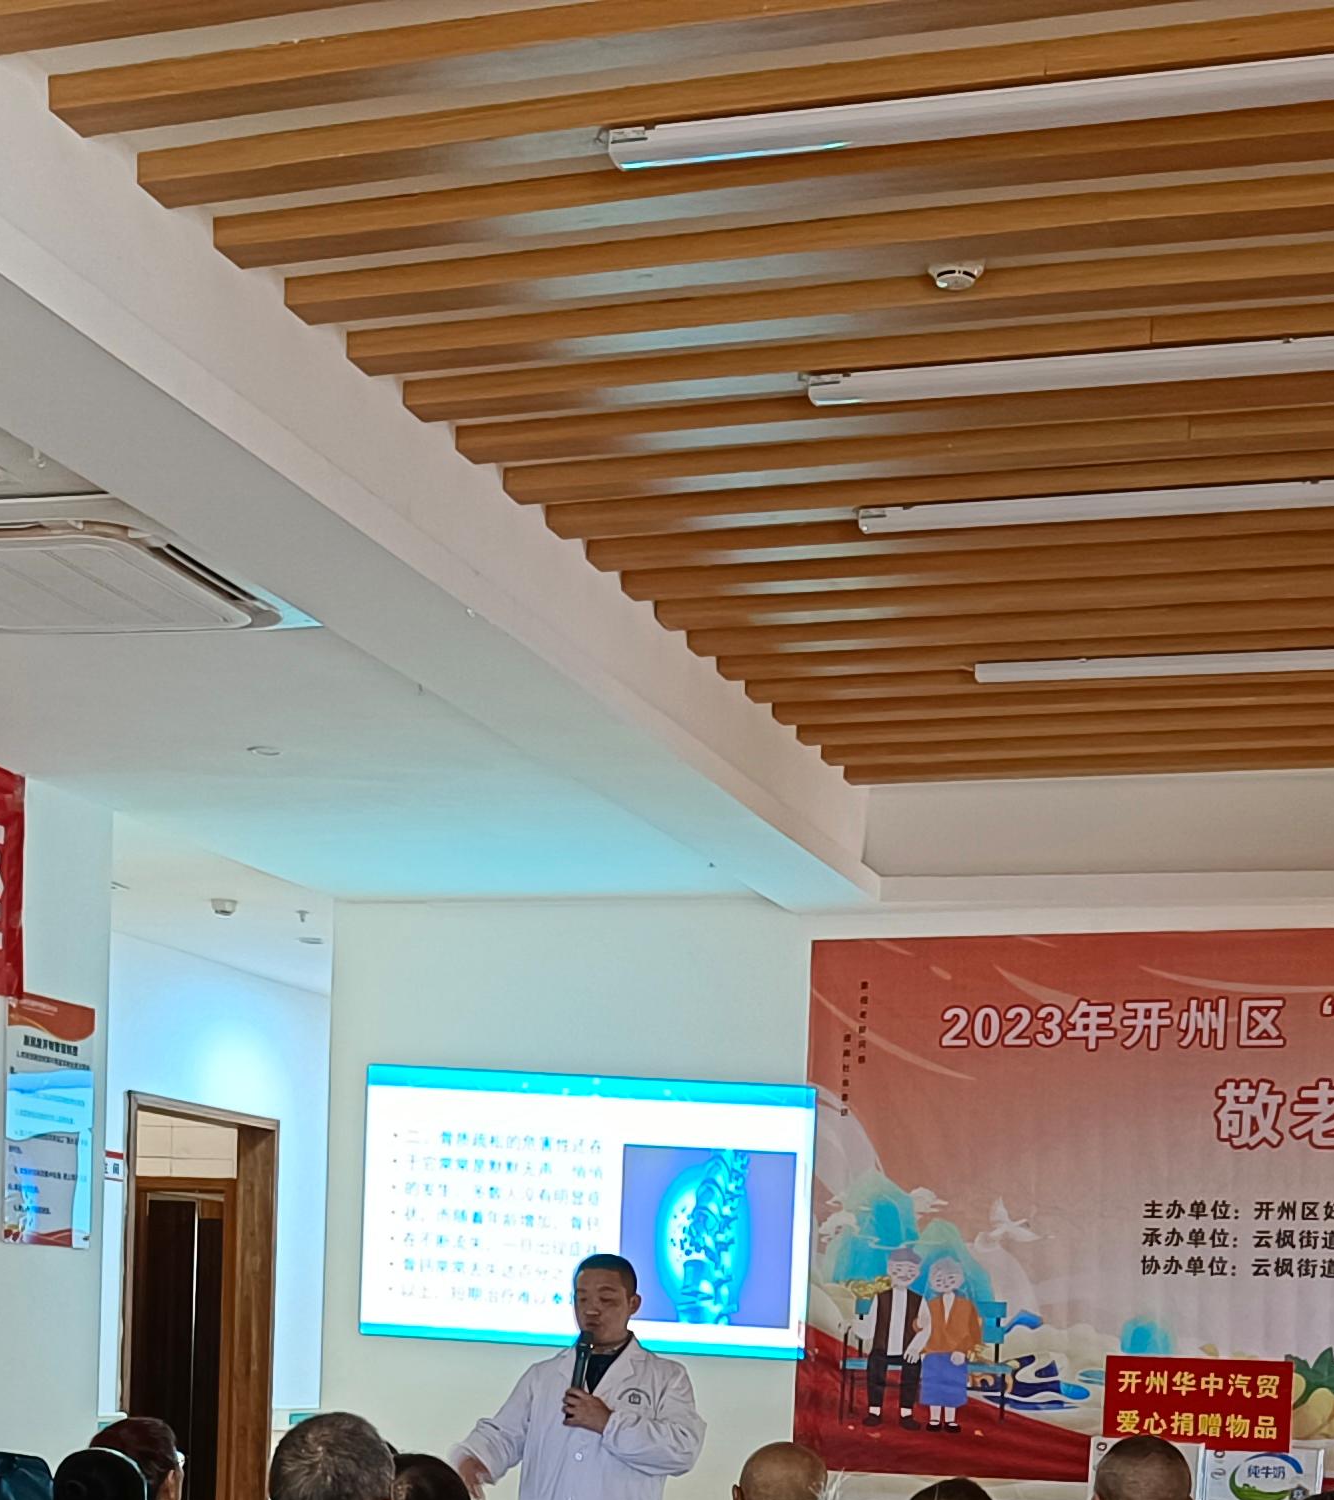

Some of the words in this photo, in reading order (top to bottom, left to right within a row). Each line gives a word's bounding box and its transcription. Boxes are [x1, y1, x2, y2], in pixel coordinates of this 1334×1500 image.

[1117, 1370, 1281, 1399] 开州华中汽贸
[1116, 1409, 1278, 1440] 爱心捐赠物品
[1247, 1464, 1286, 1479] 纯牛奶
